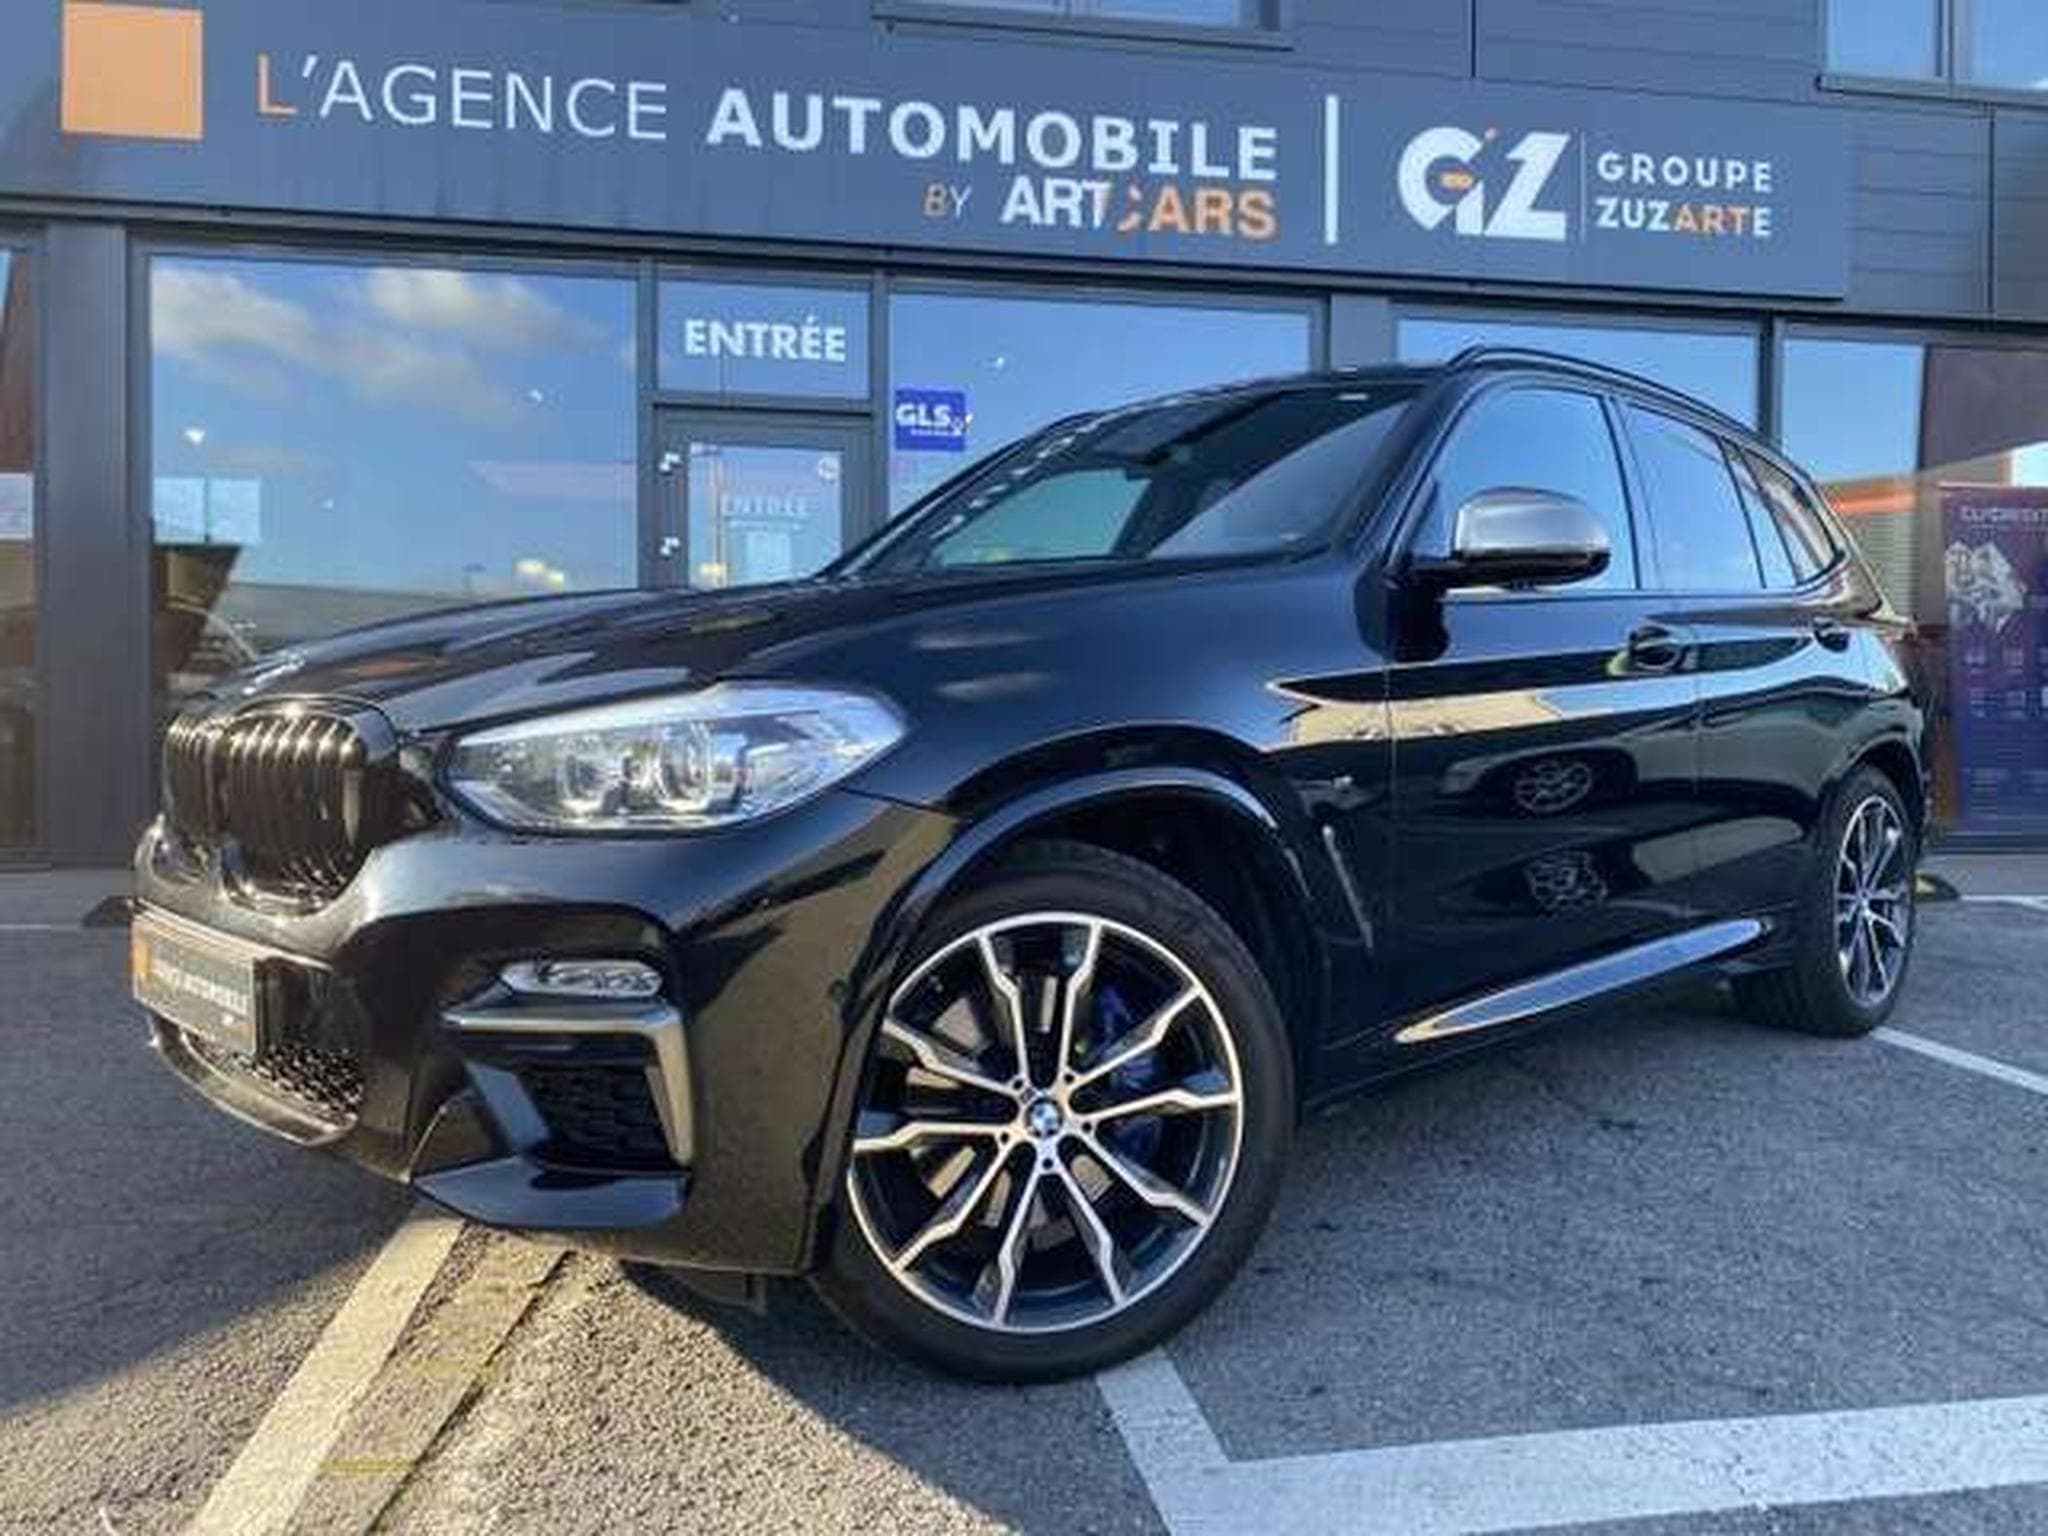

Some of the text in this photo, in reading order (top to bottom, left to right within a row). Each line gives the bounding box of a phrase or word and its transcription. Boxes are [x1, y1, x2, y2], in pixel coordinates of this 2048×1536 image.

[256, 52, 1278, 181] L'AGENCE AUTOMOBILE
[1597, 151, 1772, 193] GROUPE
[922, 183, 972, 219] BY
[1596, 197, 1772, 237] ZUZARTE
[684, 314, 846, 362] ENTRÉE
[896, 403, 951, 428] GLS
